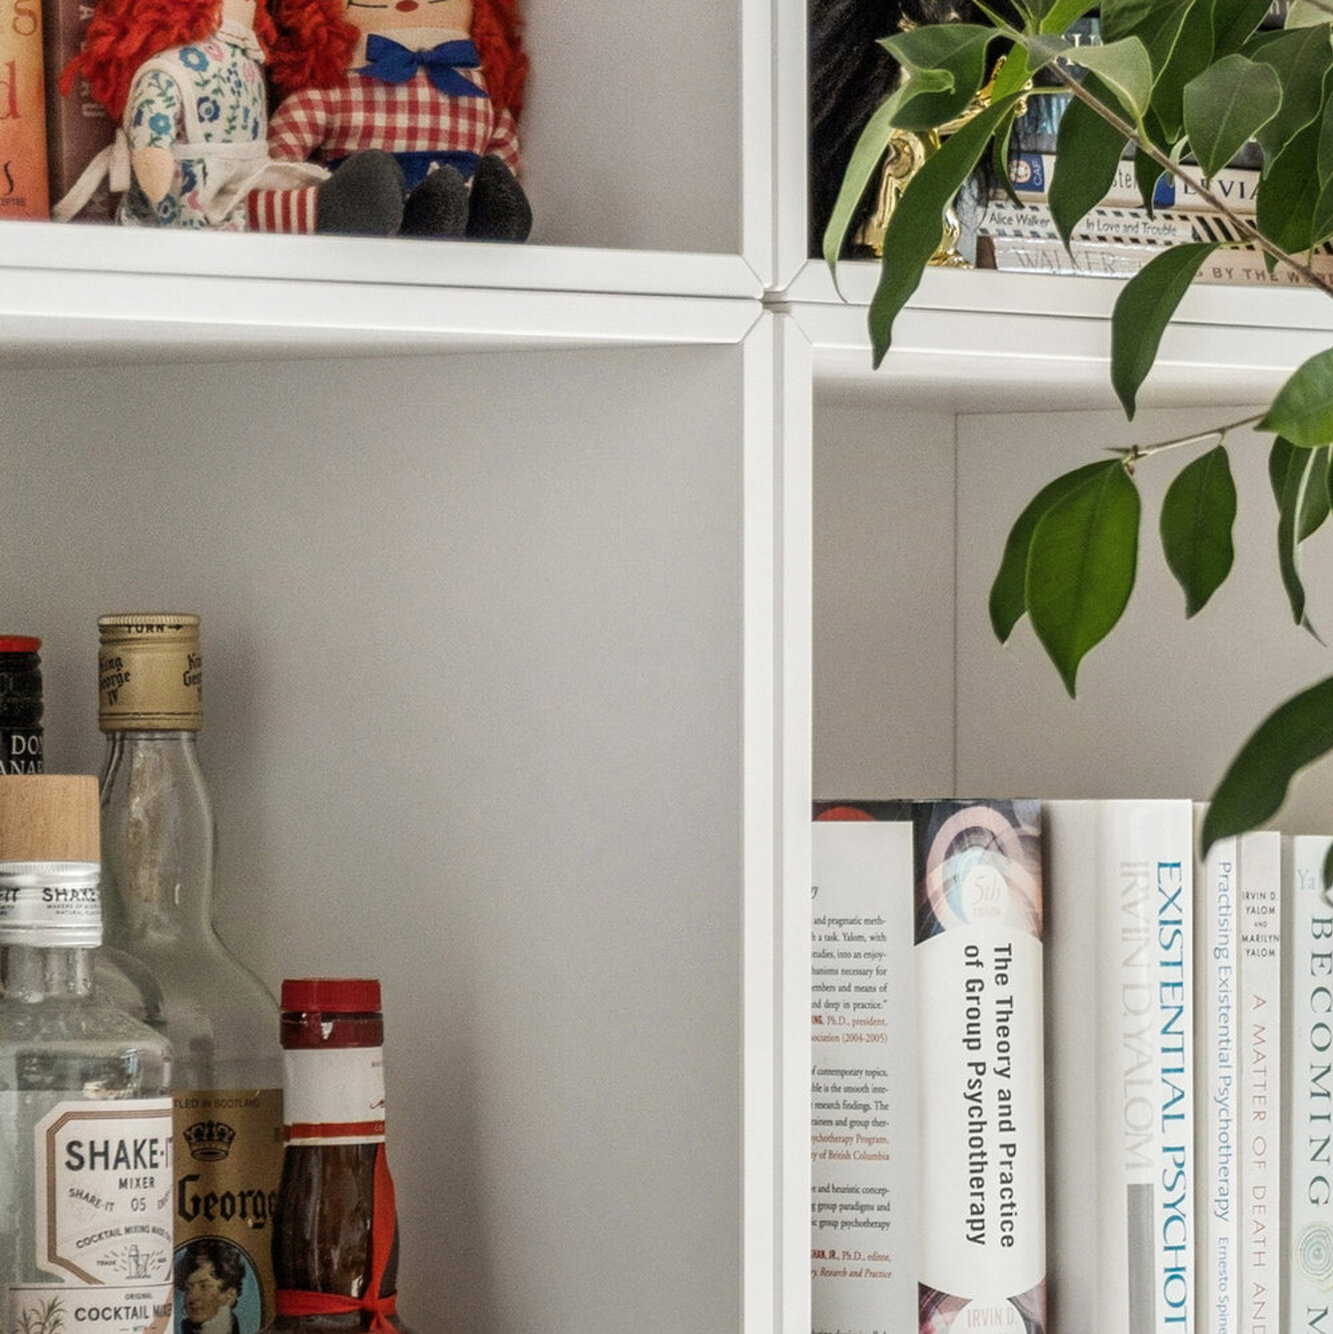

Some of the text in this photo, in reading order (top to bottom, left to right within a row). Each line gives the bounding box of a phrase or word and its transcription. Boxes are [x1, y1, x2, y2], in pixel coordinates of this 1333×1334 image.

[990, 212, 1050, 228] Alice Walker
[1085, 217, 1178, 237] In Love and Trouble
[1212, 267, 1234, 280] BY
[1241, 891, 1267, 901] IRVIN
[1245, 905, 1276, 916] YALOM
[827, 916, 863, 929] pragmatic
[841, 931, 887, 944] Yalom, with
[1241, 933, 1280, 944] MARILYN
[1245, 947, 1276, 958] YALOM
[840, 967, 874, 979] necessary
[1156, 860, 1187, 1135] EXISTENTIAL
[842, 1032, 888, 1045] (2004-2005)
[1212, 860, 1233, 1224] Practising Existential Psychotherapy
[1307, 916, 1333, 1207] BECOMING
[1251, 1023, 1268, 1122] MATTER
[992, 942, 1017, 1249] The Theory and Practice
[1122, 1021, 1155, 1172] YALOM
[962, 978, 987, 1247] Group Psychotherapy
[1251, 1135, 1268, 1171] OF
[118, 1176, 156, 1191] MIXER
[68, 1187, 116, 1213] SHARE-IT
[840, 1218, 892, 1232] psychotherapy
[1251, 1186, 1268, 1268] DEATH
[75, 1223, 151, 1250] COCKTAIL MIXING
[74, 1304, 151, 1323] COCKTAIL
[966, 1307, 1002, 1328] IRVIN
